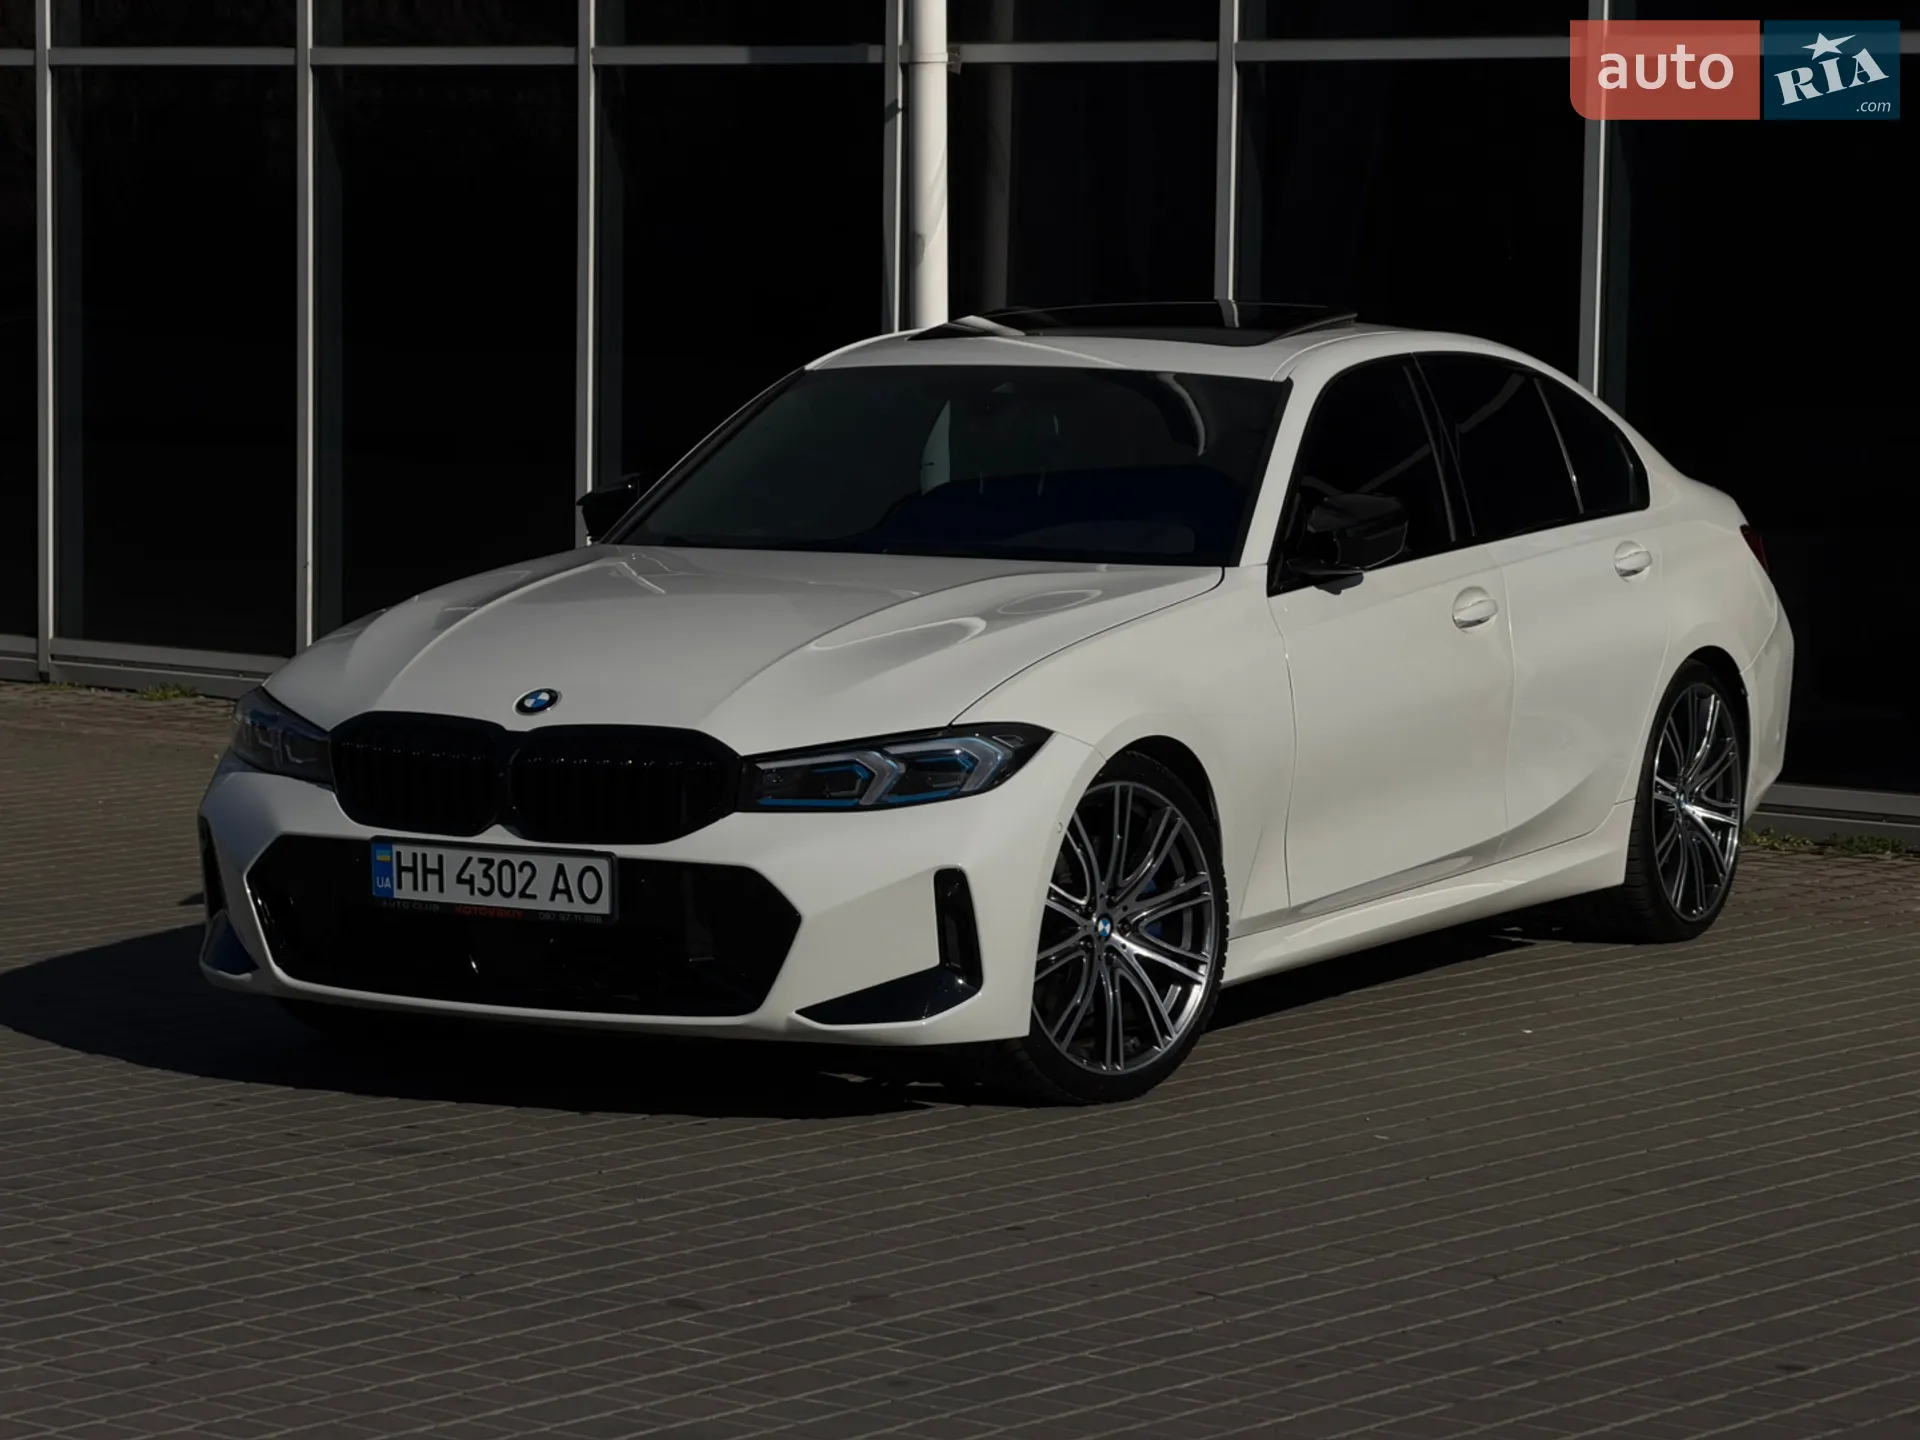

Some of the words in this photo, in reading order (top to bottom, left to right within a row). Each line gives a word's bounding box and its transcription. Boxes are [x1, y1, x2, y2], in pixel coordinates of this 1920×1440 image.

[376, 876, 391, 889] UA
[395, 851, 444, 893] HH
[456, 856, 538, 900] 4302
[549, 863, 604, 905] AO
